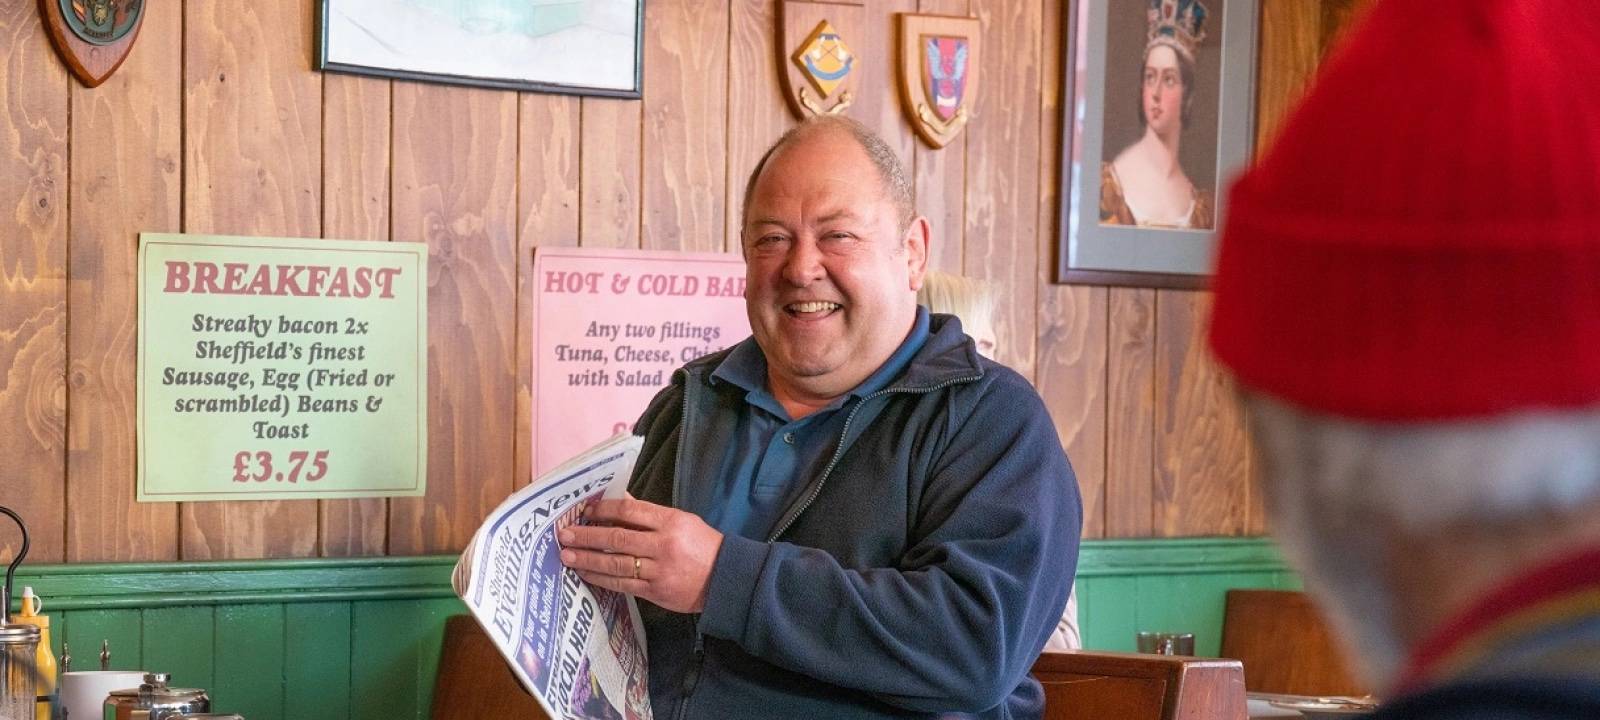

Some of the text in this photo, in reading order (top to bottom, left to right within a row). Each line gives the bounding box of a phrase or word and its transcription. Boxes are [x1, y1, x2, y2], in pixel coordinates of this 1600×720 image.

[163, 261, 402, 299] BREAKFAST
[544, 271, 604, 294] HOT
[611, 273, 631, 295] &
[637, 274, 699, 297] COLD
[192, 314, 369, 338] Streaky bacon 2x
[585, 321, 722, 343] Any two fillings
[196, 341, 366, 365] Sheffield's finest
[555, 344, 609, 365] Tuna,
[614, 346, 675, 365] Cheese,
[162, 367, 396, 392] Sausage, Egg (Fried or
[568, 370, 609, 387] with
[615, 371, 663, 387] Salad
[175, 394, 383, 418] scrambled) Beans &
[253, 421, 310, 439] Toast
[233, 450, 330, 484] £3.75
[489, 526, 512, 602] Sheffield
[568, 595, 594, 657] HERO
